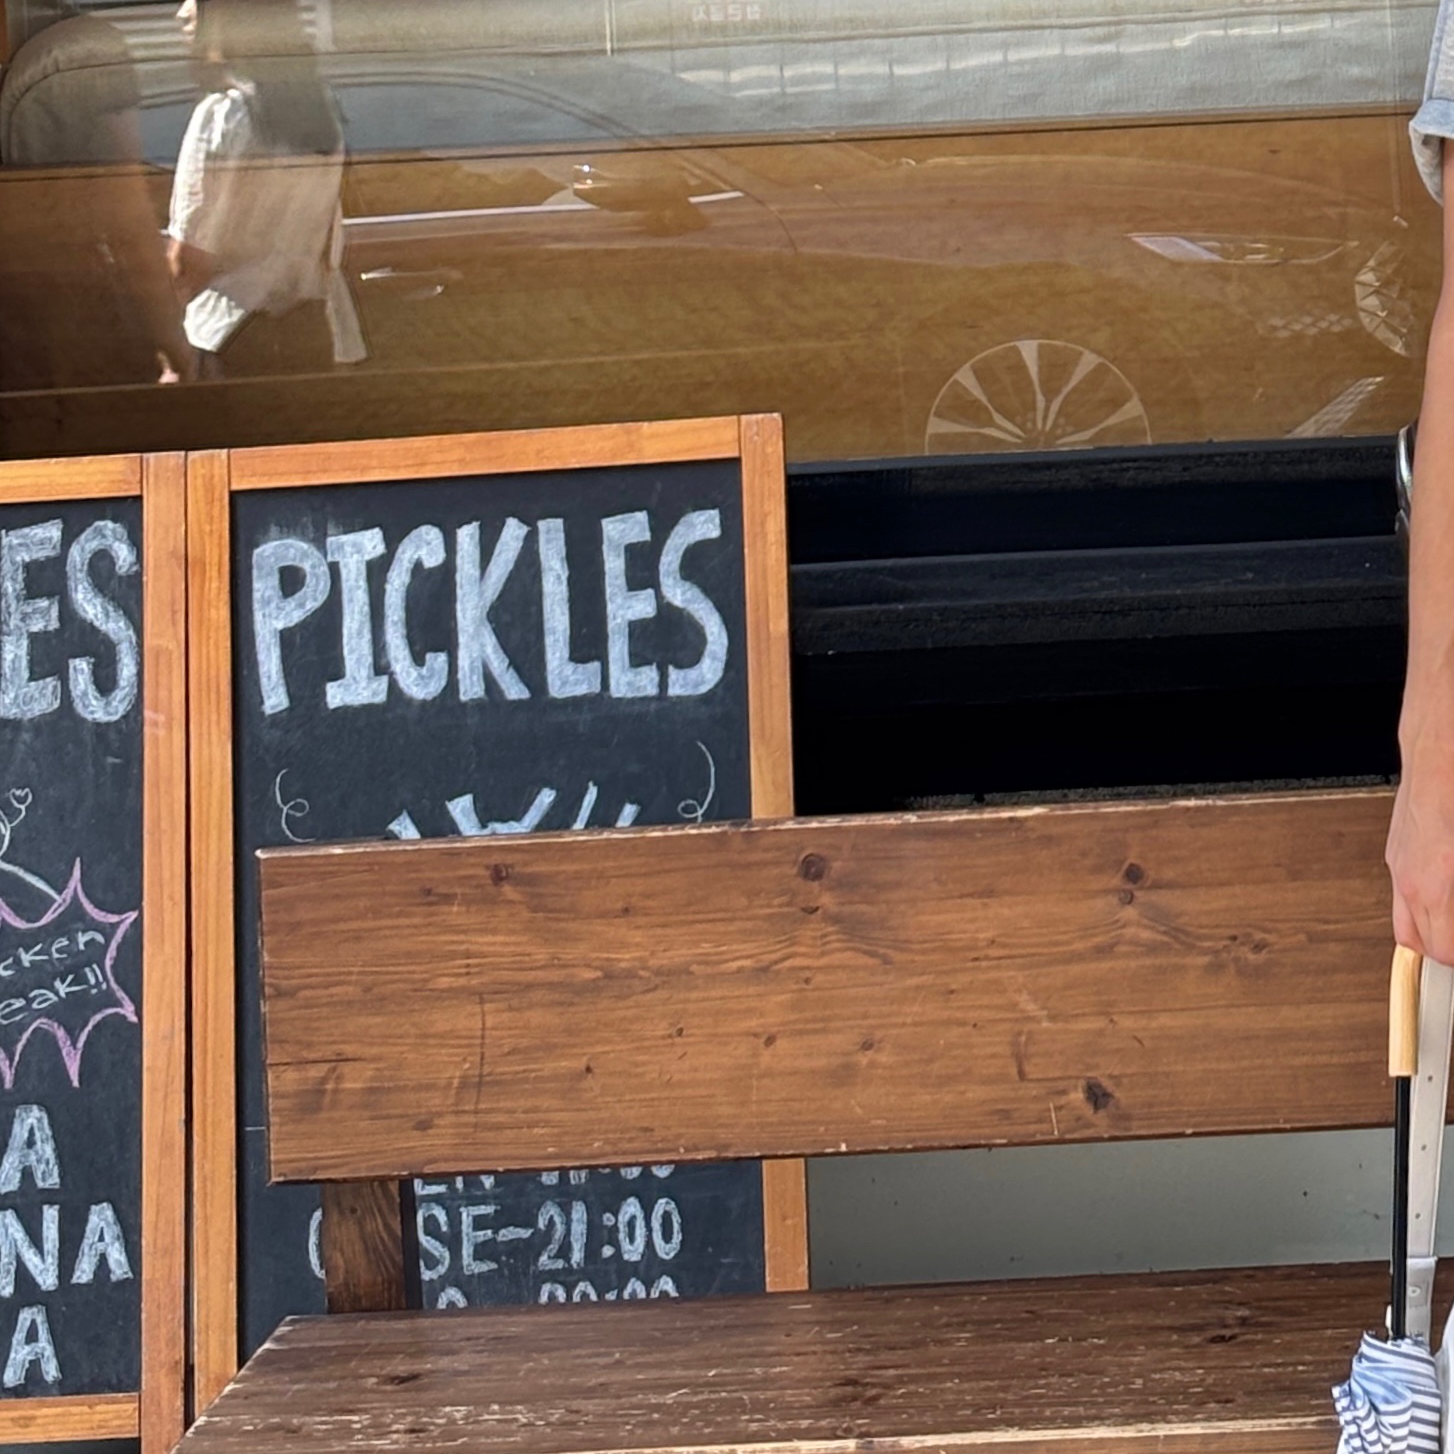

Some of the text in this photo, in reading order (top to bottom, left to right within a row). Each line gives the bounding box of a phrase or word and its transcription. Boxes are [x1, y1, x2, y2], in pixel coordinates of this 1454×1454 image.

[0, 518, 140, 723] ES
[251, 509, 730, 715] PICKLES
[0, 1201, 135, 1299] NA
[3, 1303, 63, 1388] A
